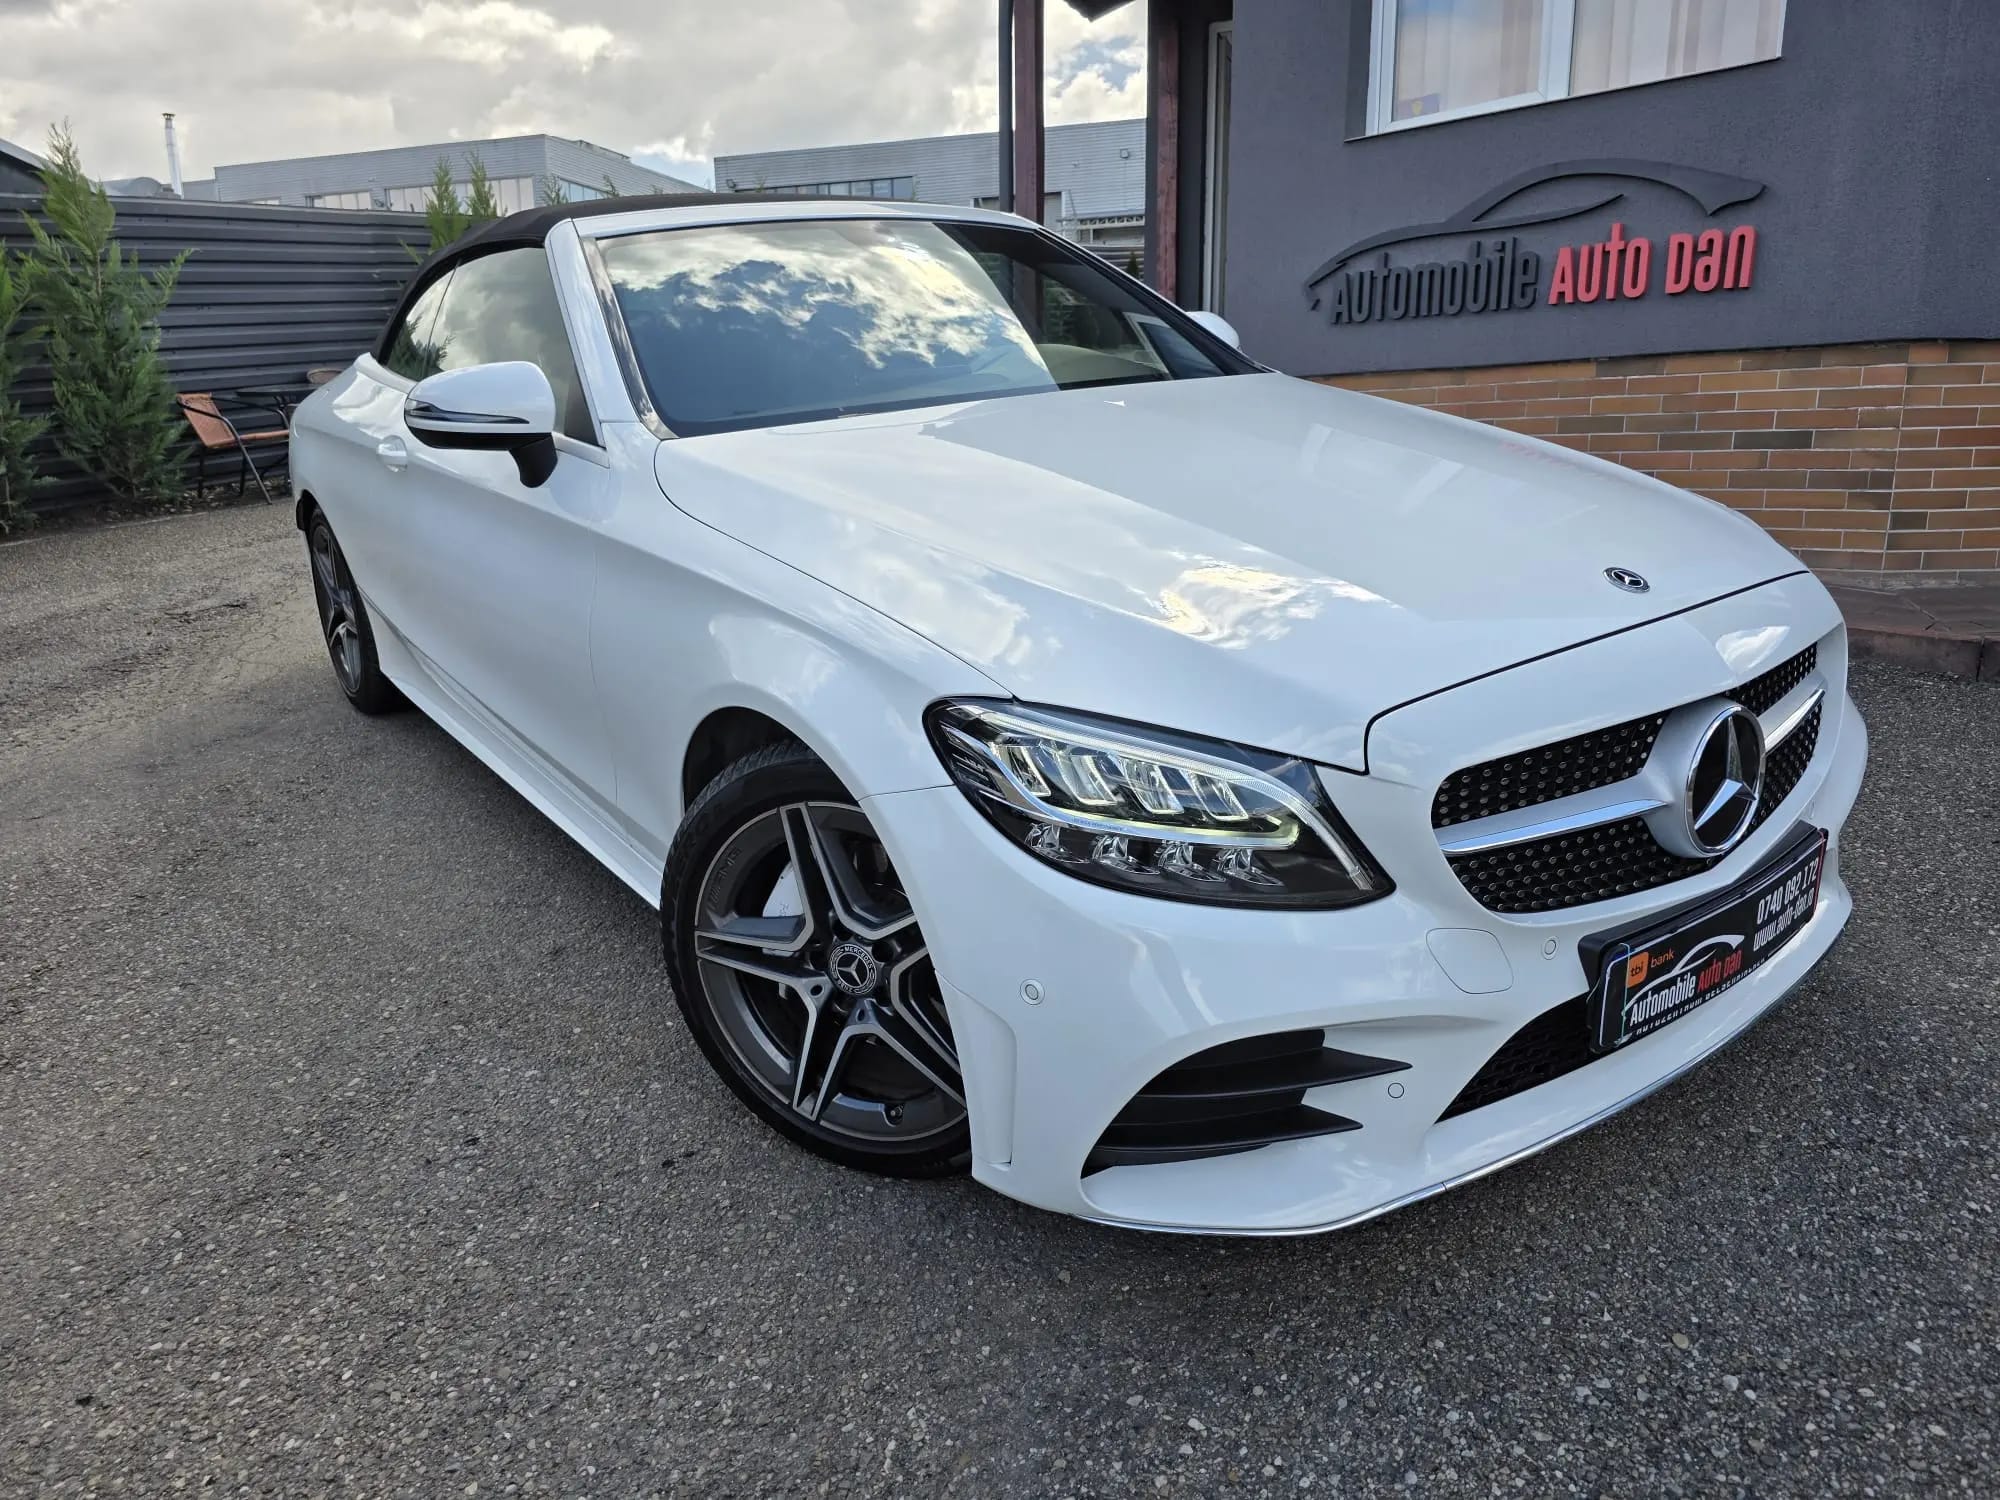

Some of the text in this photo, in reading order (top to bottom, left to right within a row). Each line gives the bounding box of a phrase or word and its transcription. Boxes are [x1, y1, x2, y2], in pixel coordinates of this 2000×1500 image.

[1330, 222, 1758, 325] Automobile Auto Dan
[1757, 857, 1819, 925] 0740 092 172
[1629, 972, 1697, 1027] Automobile
[1697, 959, 1722, 993] Auto
[1630, 948, 1675, 977] tbi bank
